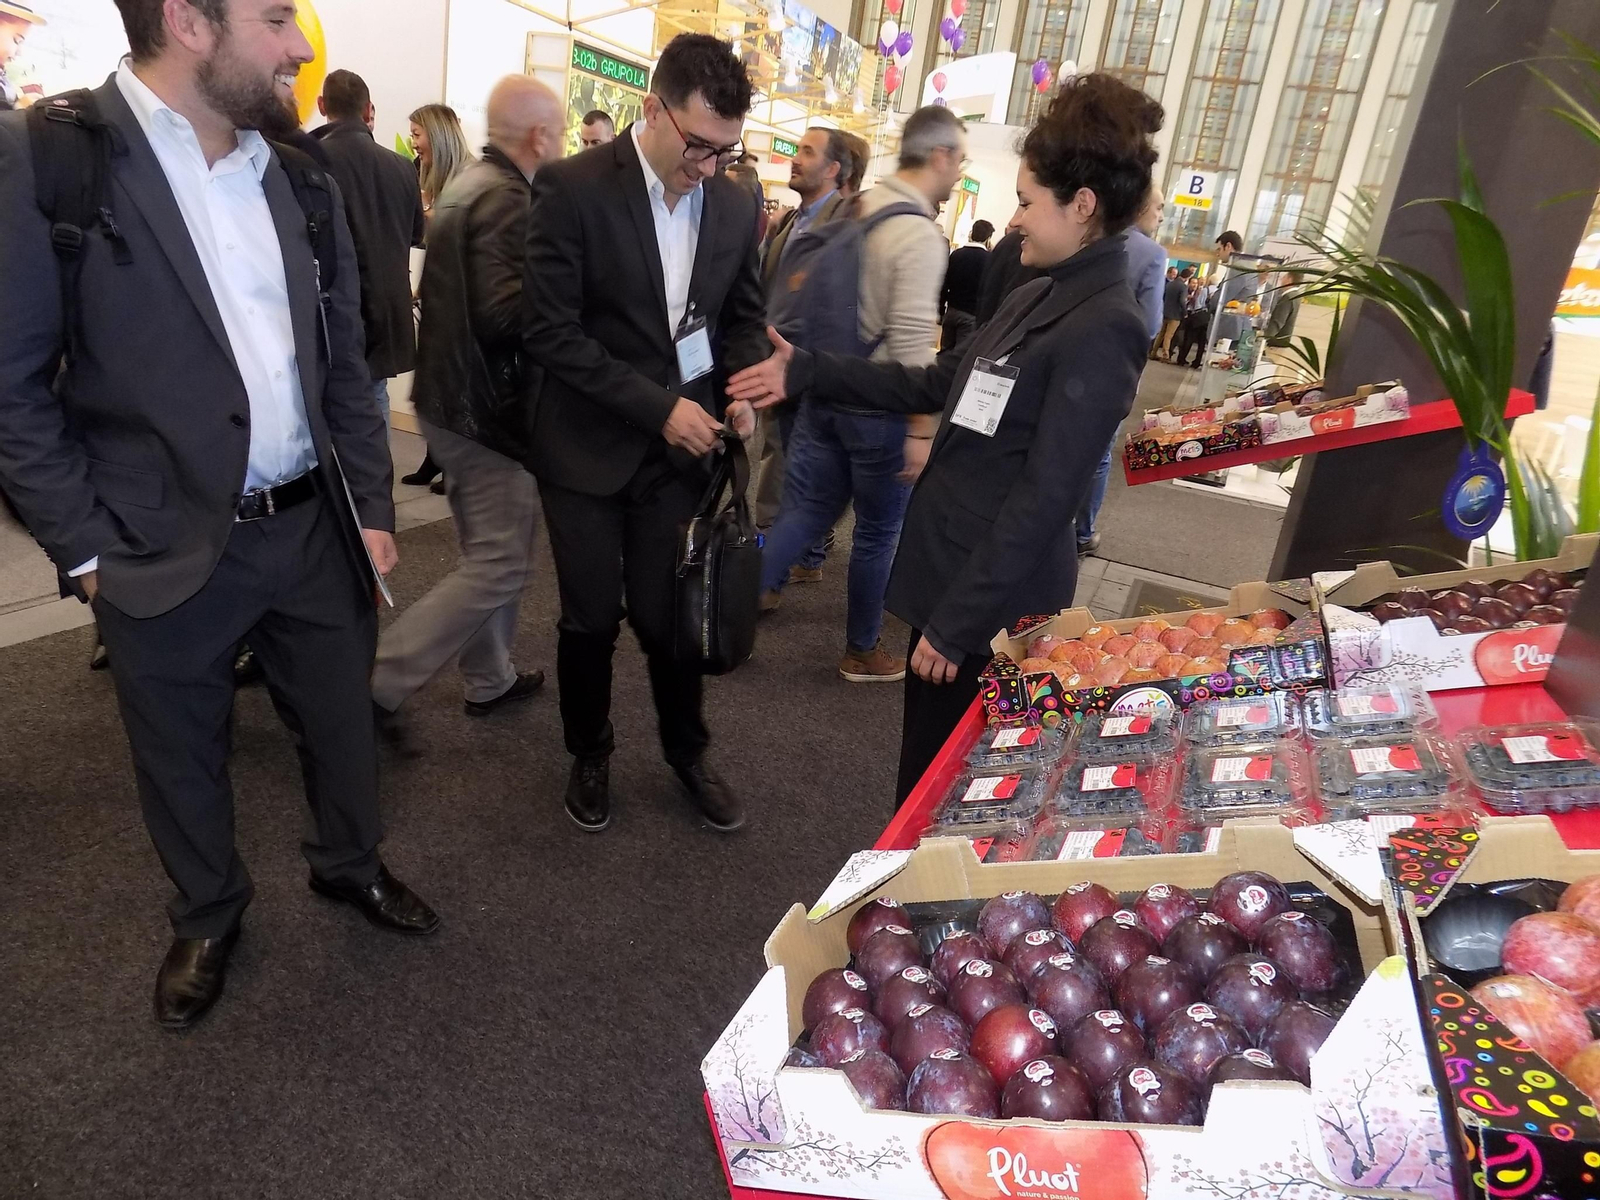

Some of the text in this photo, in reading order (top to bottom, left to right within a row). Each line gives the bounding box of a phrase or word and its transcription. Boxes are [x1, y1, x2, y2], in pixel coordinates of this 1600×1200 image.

[1189, 175, 1205, 195] B
[1193, 199, 1203, 207] 18
[1511, 643, 1555, 673] Plu
[986, 1146, 1081, 1197] Pluot
